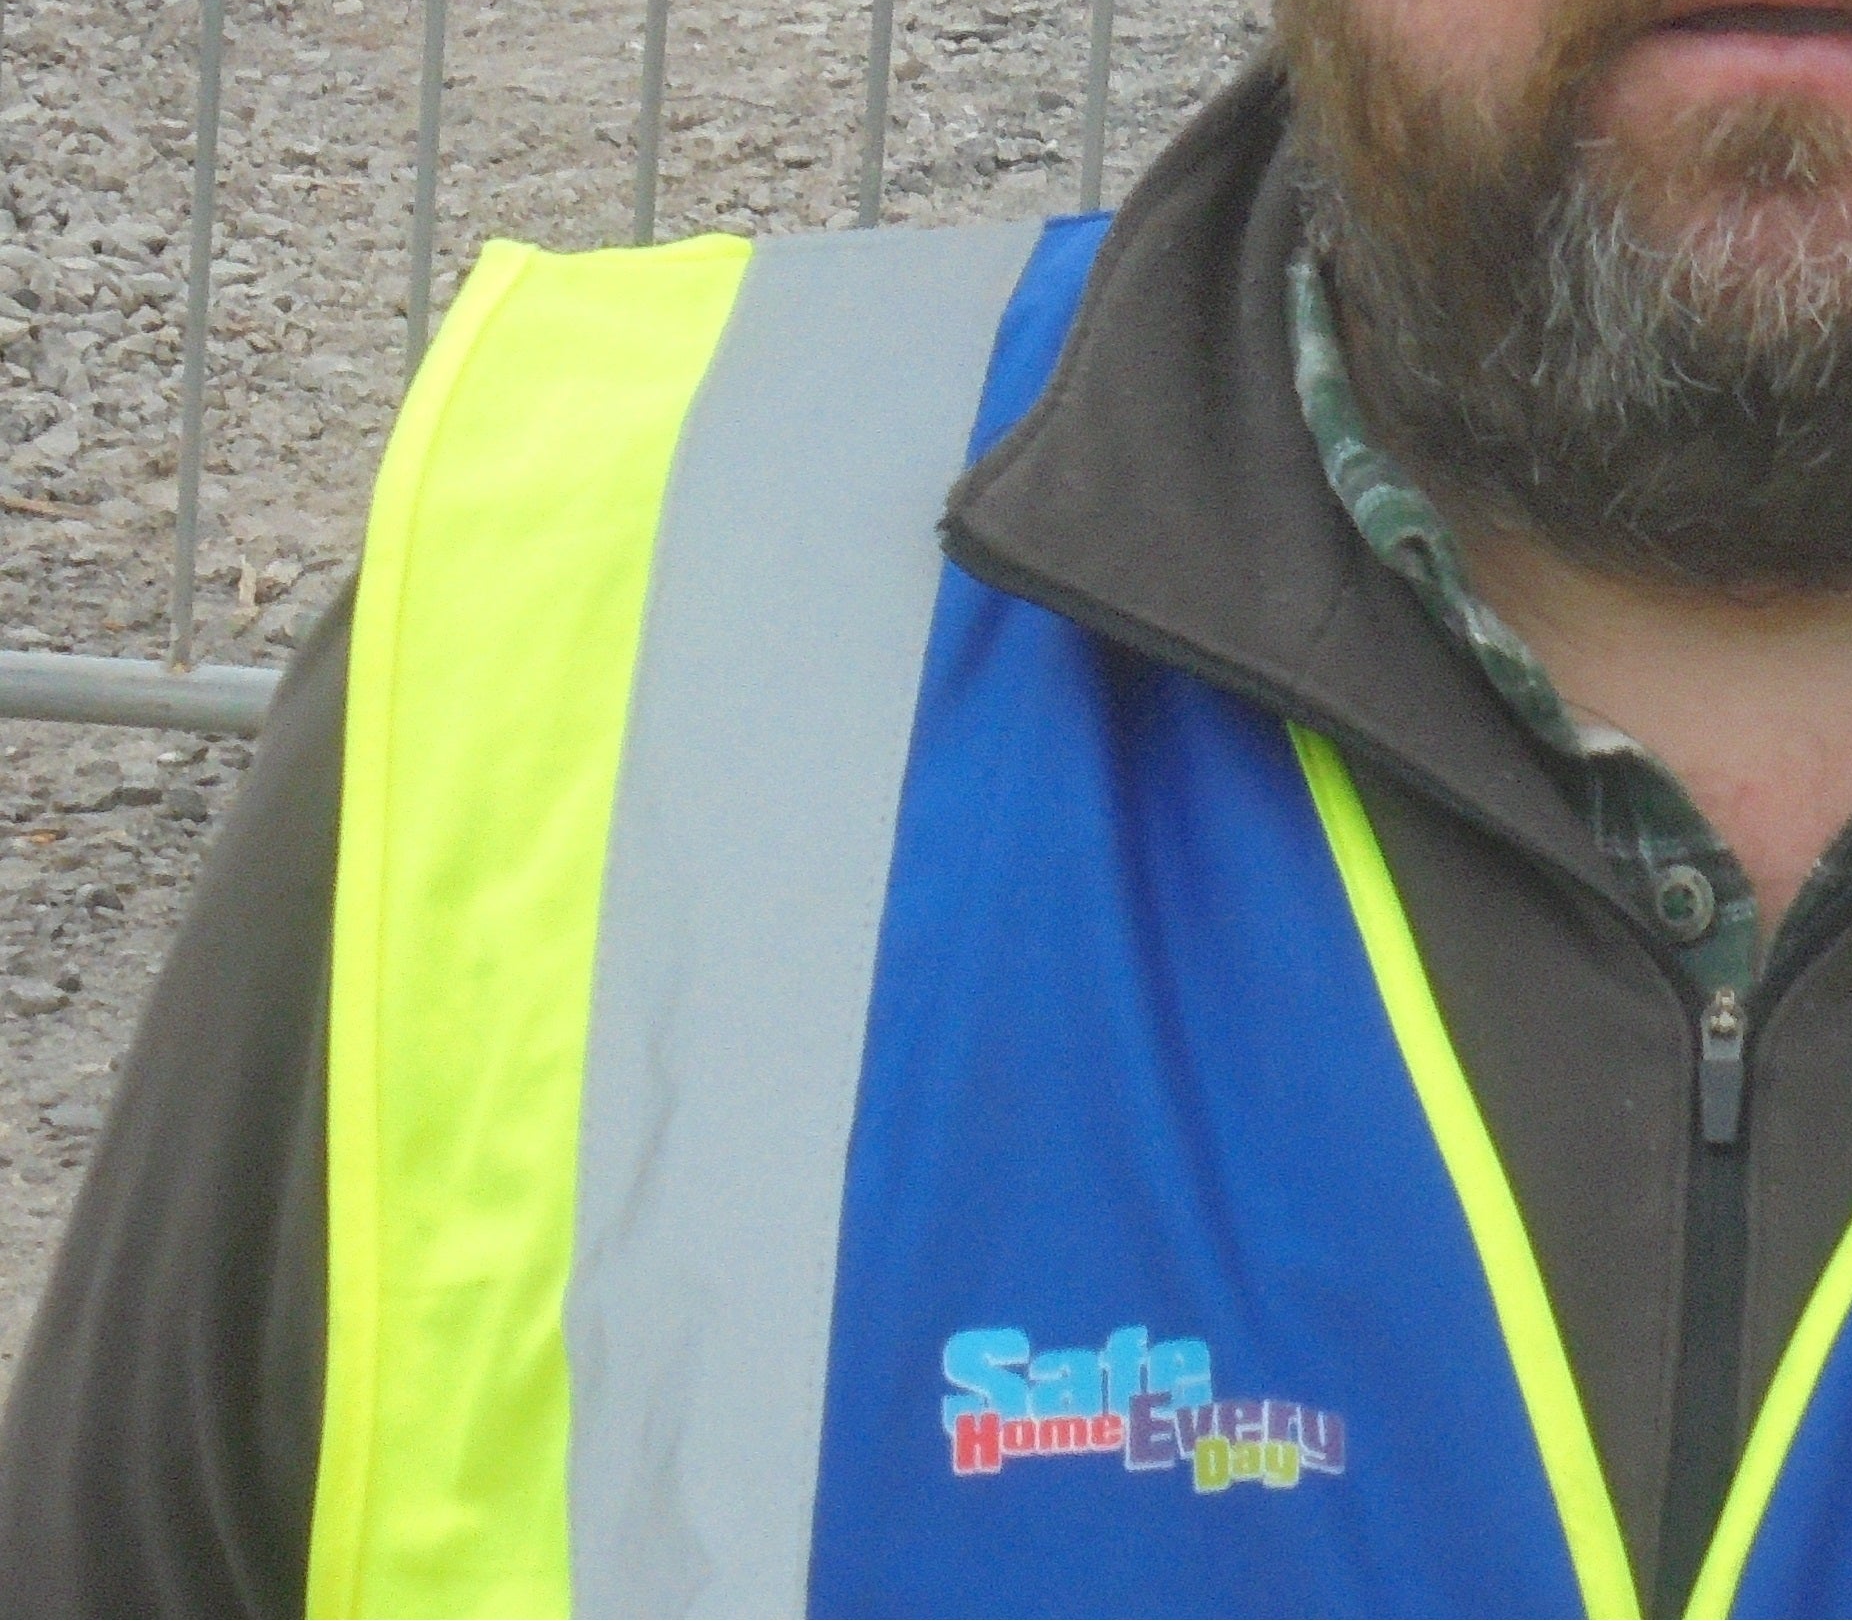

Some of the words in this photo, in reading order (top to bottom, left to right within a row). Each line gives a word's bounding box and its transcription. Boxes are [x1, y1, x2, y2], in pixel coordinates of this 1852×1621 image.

[941, 1324, 1212, 1434] Safe
[952, 1411, 1126, 1475] Home
[1125, 1390, 1346, 1474] Every
[1193, 1435, 1301, 1494] Day
